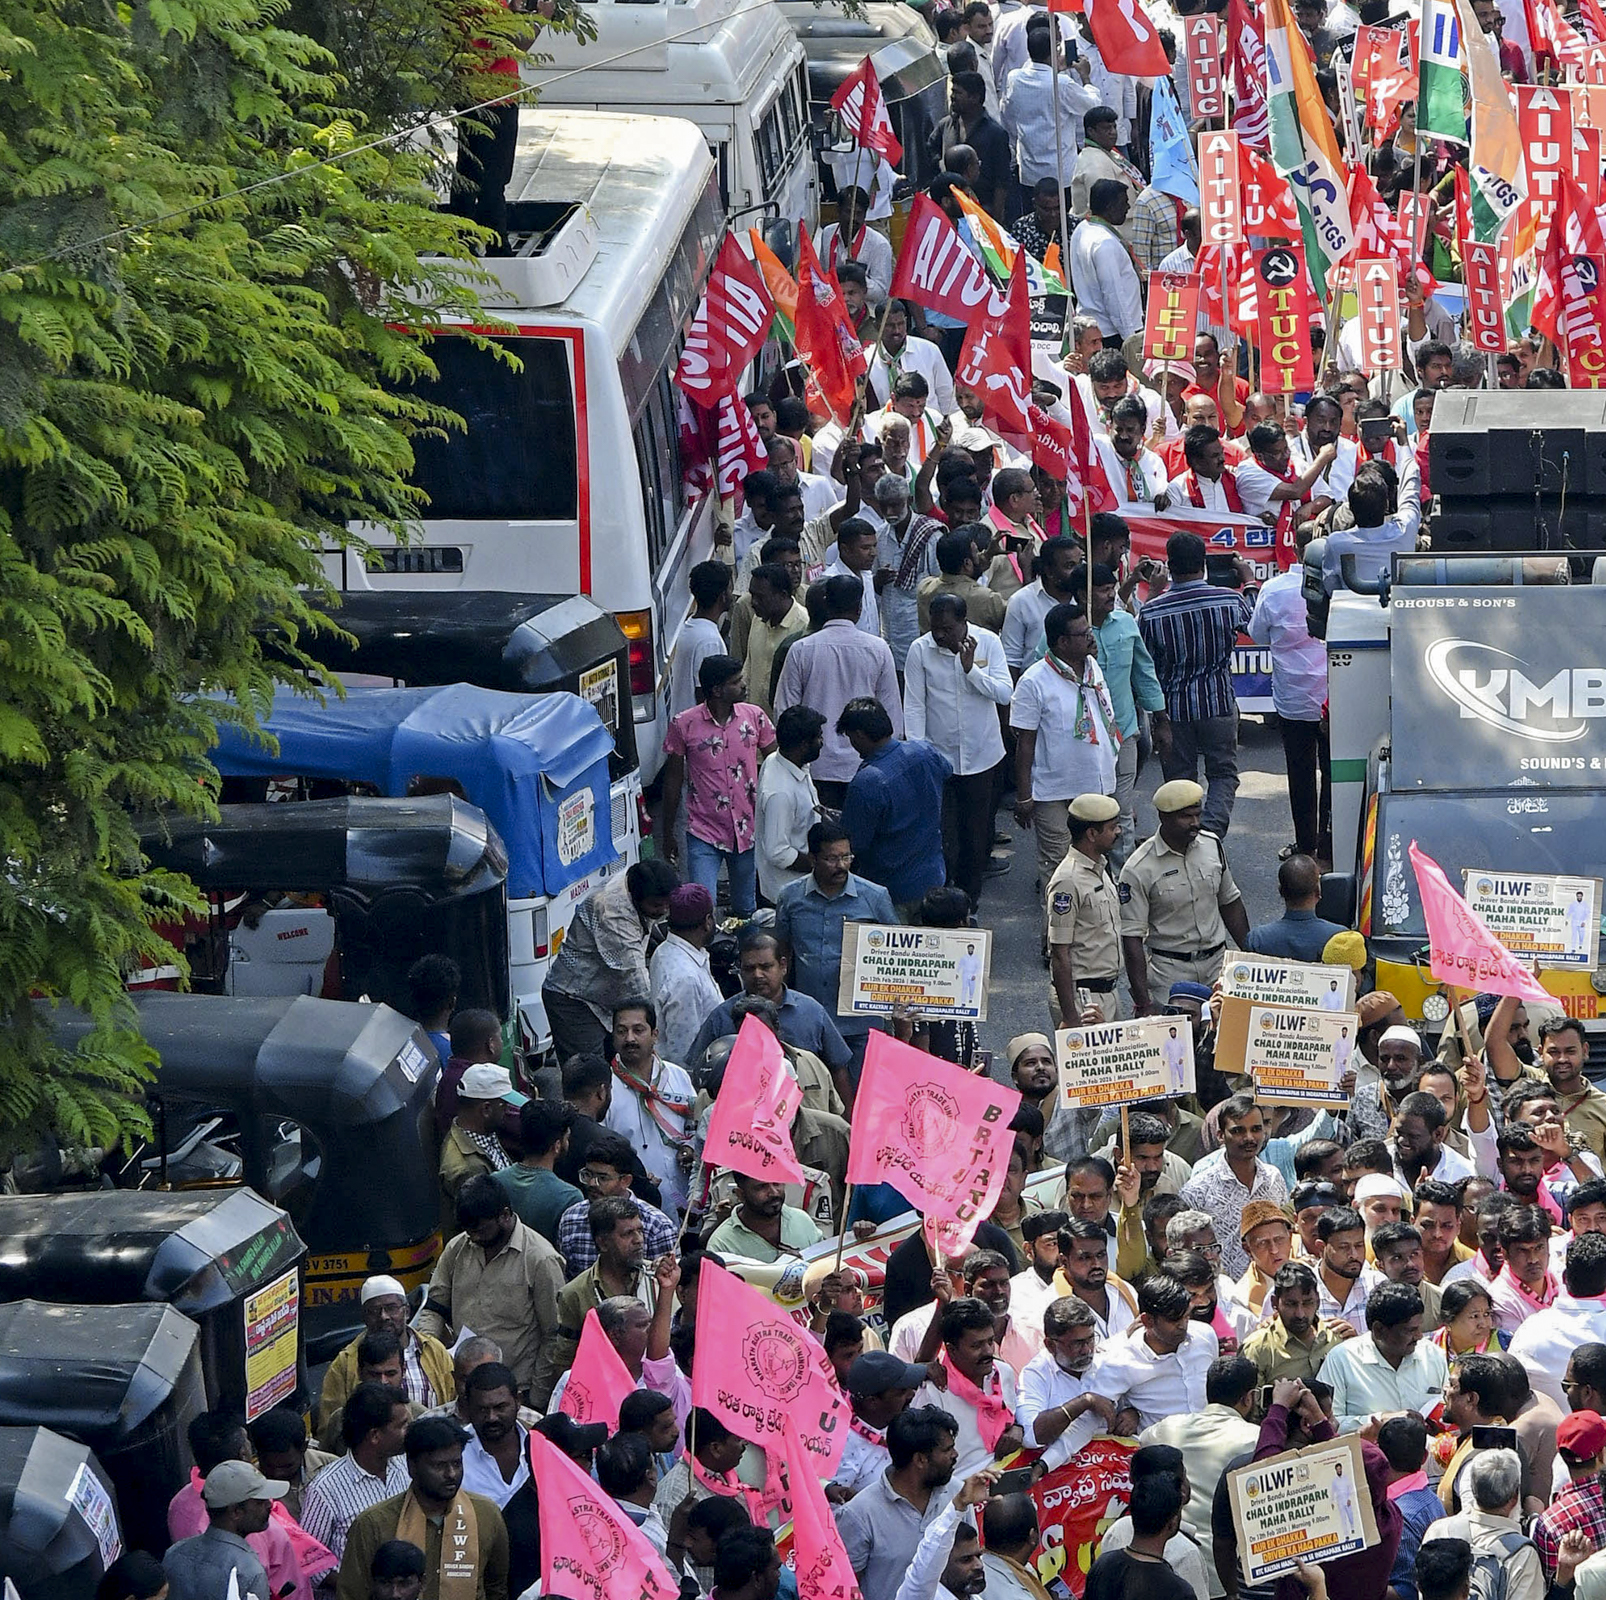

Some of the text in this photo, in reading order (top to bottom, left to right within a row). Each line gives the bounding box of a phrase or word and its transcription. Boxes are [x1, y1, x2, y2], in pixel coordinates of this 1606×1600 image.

[1190, 17, 1221, 115] AITUC
[1205, 134, 1236, 241] AITUC
[910, 224, 1011, 320] AITUC
[1150, 290, 1188, 359] IFTU
[1268, 288, 1302, 392] TUCI
[1394, 598, 1516, 608] GHOUSE & SON'S
[1520, 757, 1585, 770] SOUND'S
[1590, 757, 1601, 770] &
[569, 879, 591, 899] MADIHA
[1494, 882, 1532, 896] ILWF
[1473, 904, 1565, 916] CHALO INDRAPARK
[1486, 914, 1548, 925] MAHA RALLY
[276, 928, 309, 941] WELCOME
[886, 933, 922, 948] ILWF
[863, 956, 955, 969] CHALO INDRAPARK
[877, 967, 939, 977] MAHA RALLY
[1275, 1015, 1306, 1031] ILWF
[1085, 1028, 1123, 1048] ILWF
[1254, 1039, 1331, 1052] CHALO INDRAPARK
[1065, 1048, 1160, 1069] CHALO INDRAPARK
[1266, 1050, 1317, 1061] MAHA RALLY
[1081, 1061, 1145, 1077] MAHA RALLY
[323, 1259, 349, 1270] 3751
[774, 1329, 796, 1346] TRADE
[1260, 1468, 1293, 1493] ILWF
[1246, 1489, 1329, 1521] CHALO INDRAPARK
[1260, 1505, 1315, 1529] MAHA RALLY
[453, 1502, 467, 1563] ILWF
